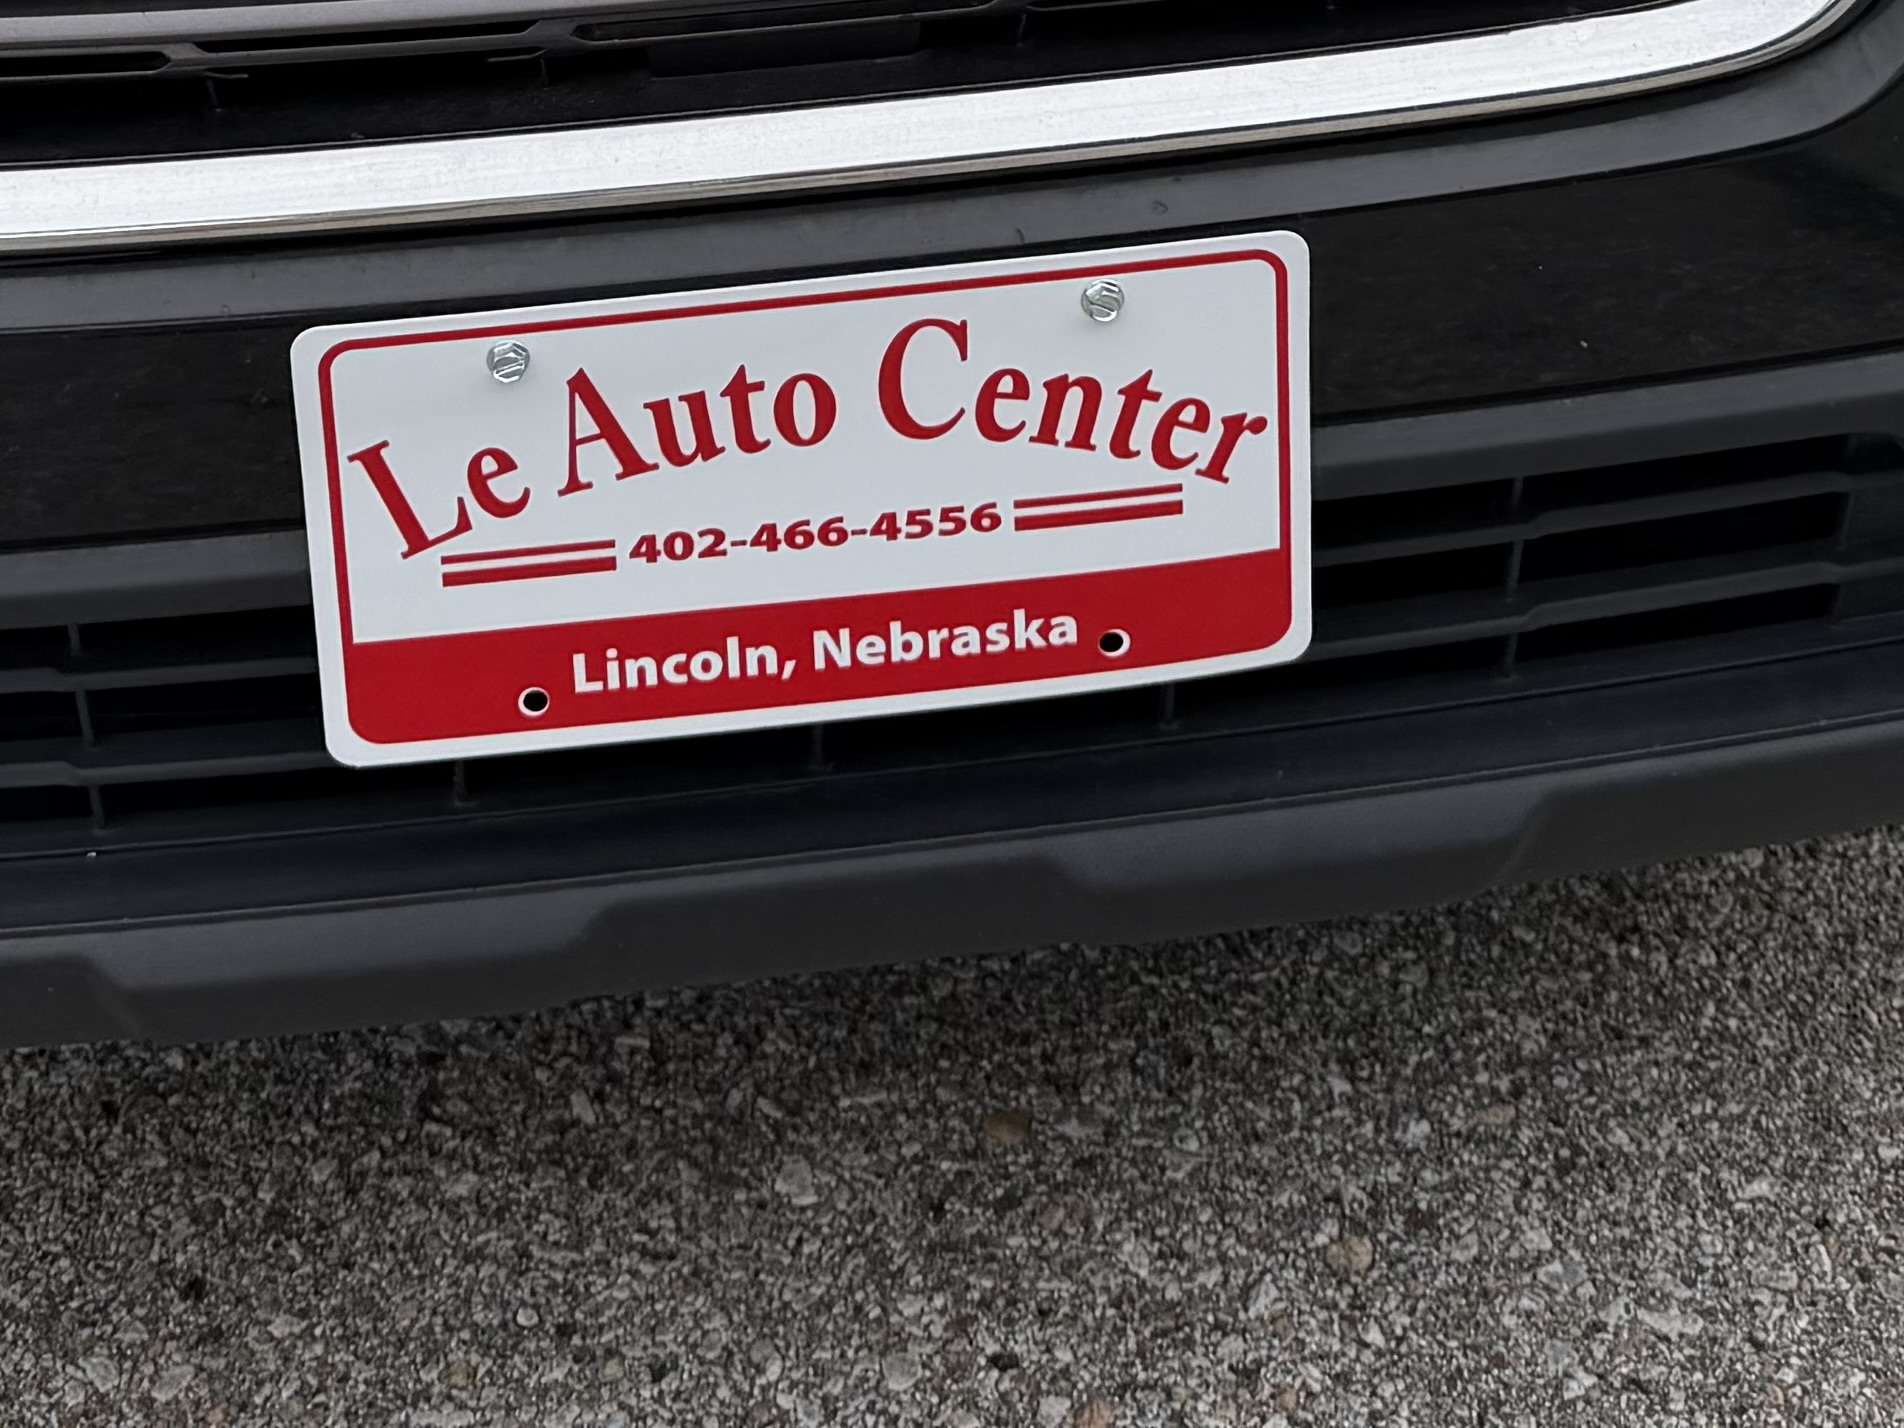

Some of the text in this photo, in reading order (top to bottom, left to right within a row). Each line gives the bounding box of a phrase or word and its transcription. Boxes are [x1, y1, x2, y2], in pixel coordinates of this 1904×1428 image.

[346, 317, 1269, 561] Le Auto Center
[629, 500, 1004, 565] 402-466-4556
[571, 607, 1080, 696] Lincoln, Nebraska
